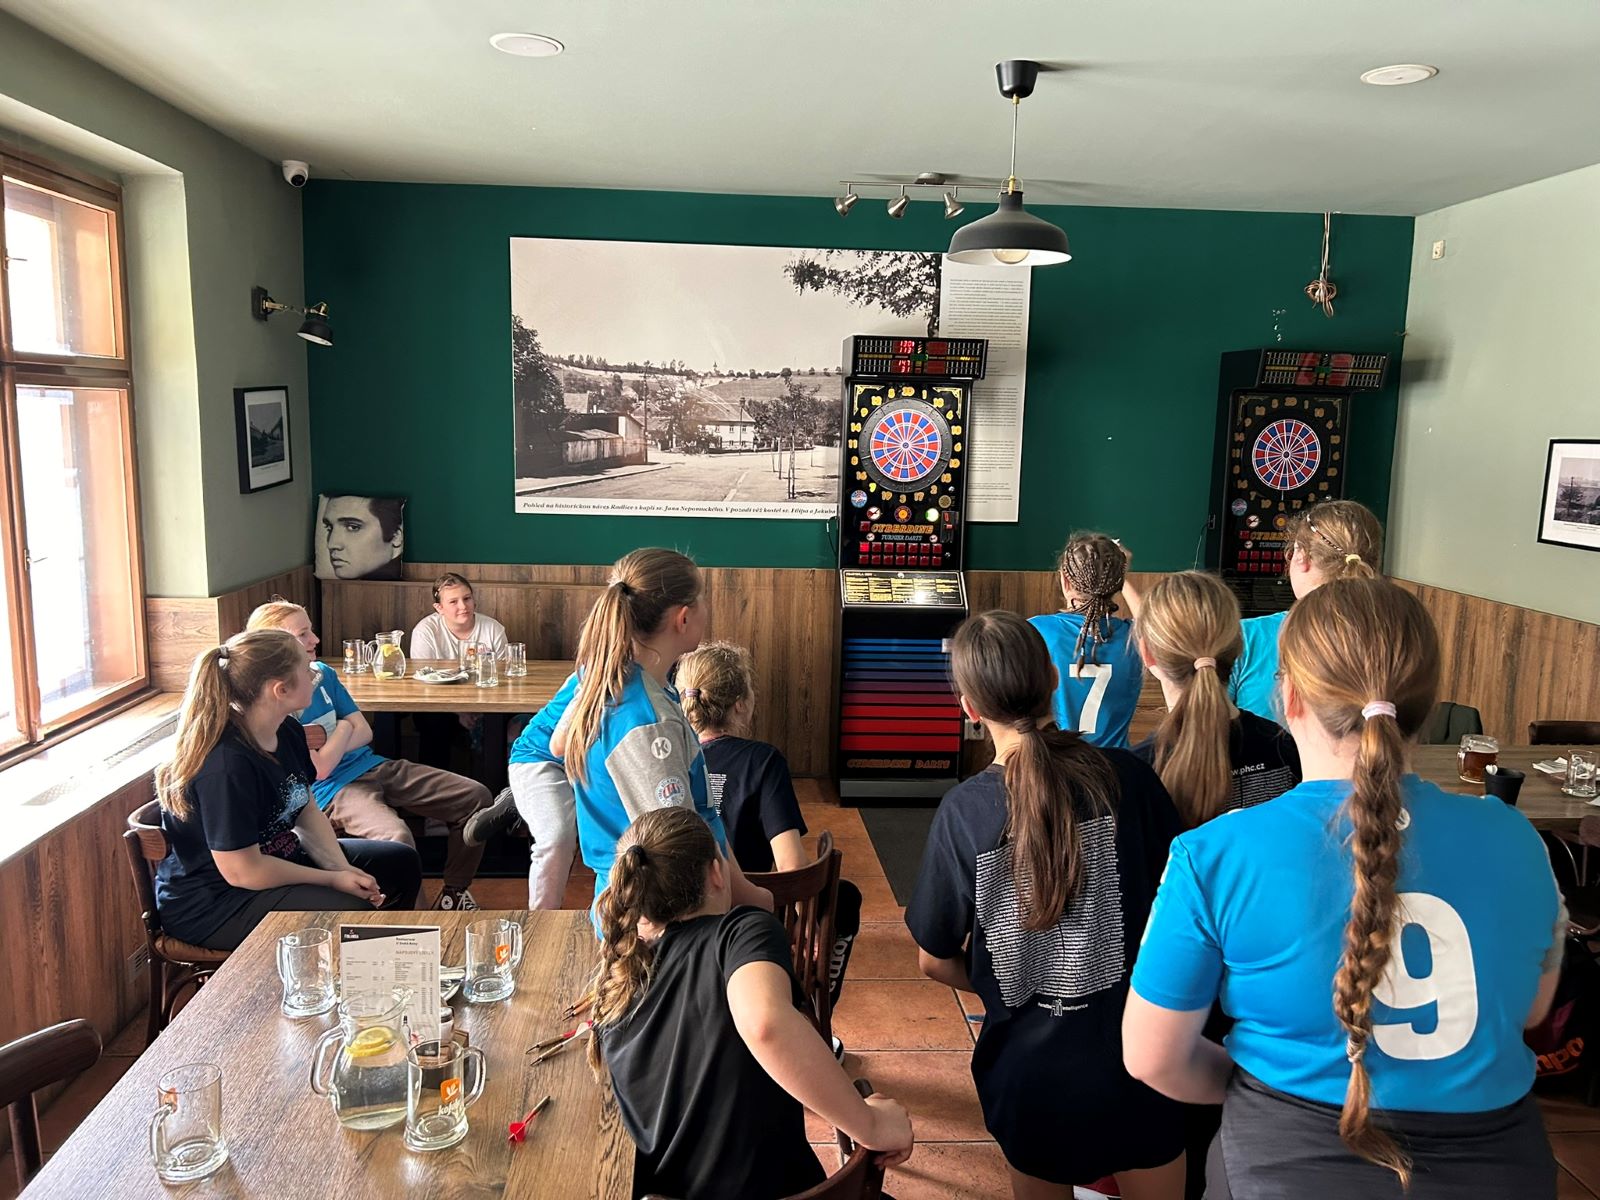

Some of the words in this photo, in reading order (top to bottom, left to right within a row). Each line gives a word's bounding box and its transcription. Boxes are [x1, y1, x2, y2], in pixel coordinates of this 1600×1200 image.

[1069, 663, 1112, 734] 7
[1231, 763, 1266, 776] w.phc.cz
[1372, 892, 1478, 1060] 9
